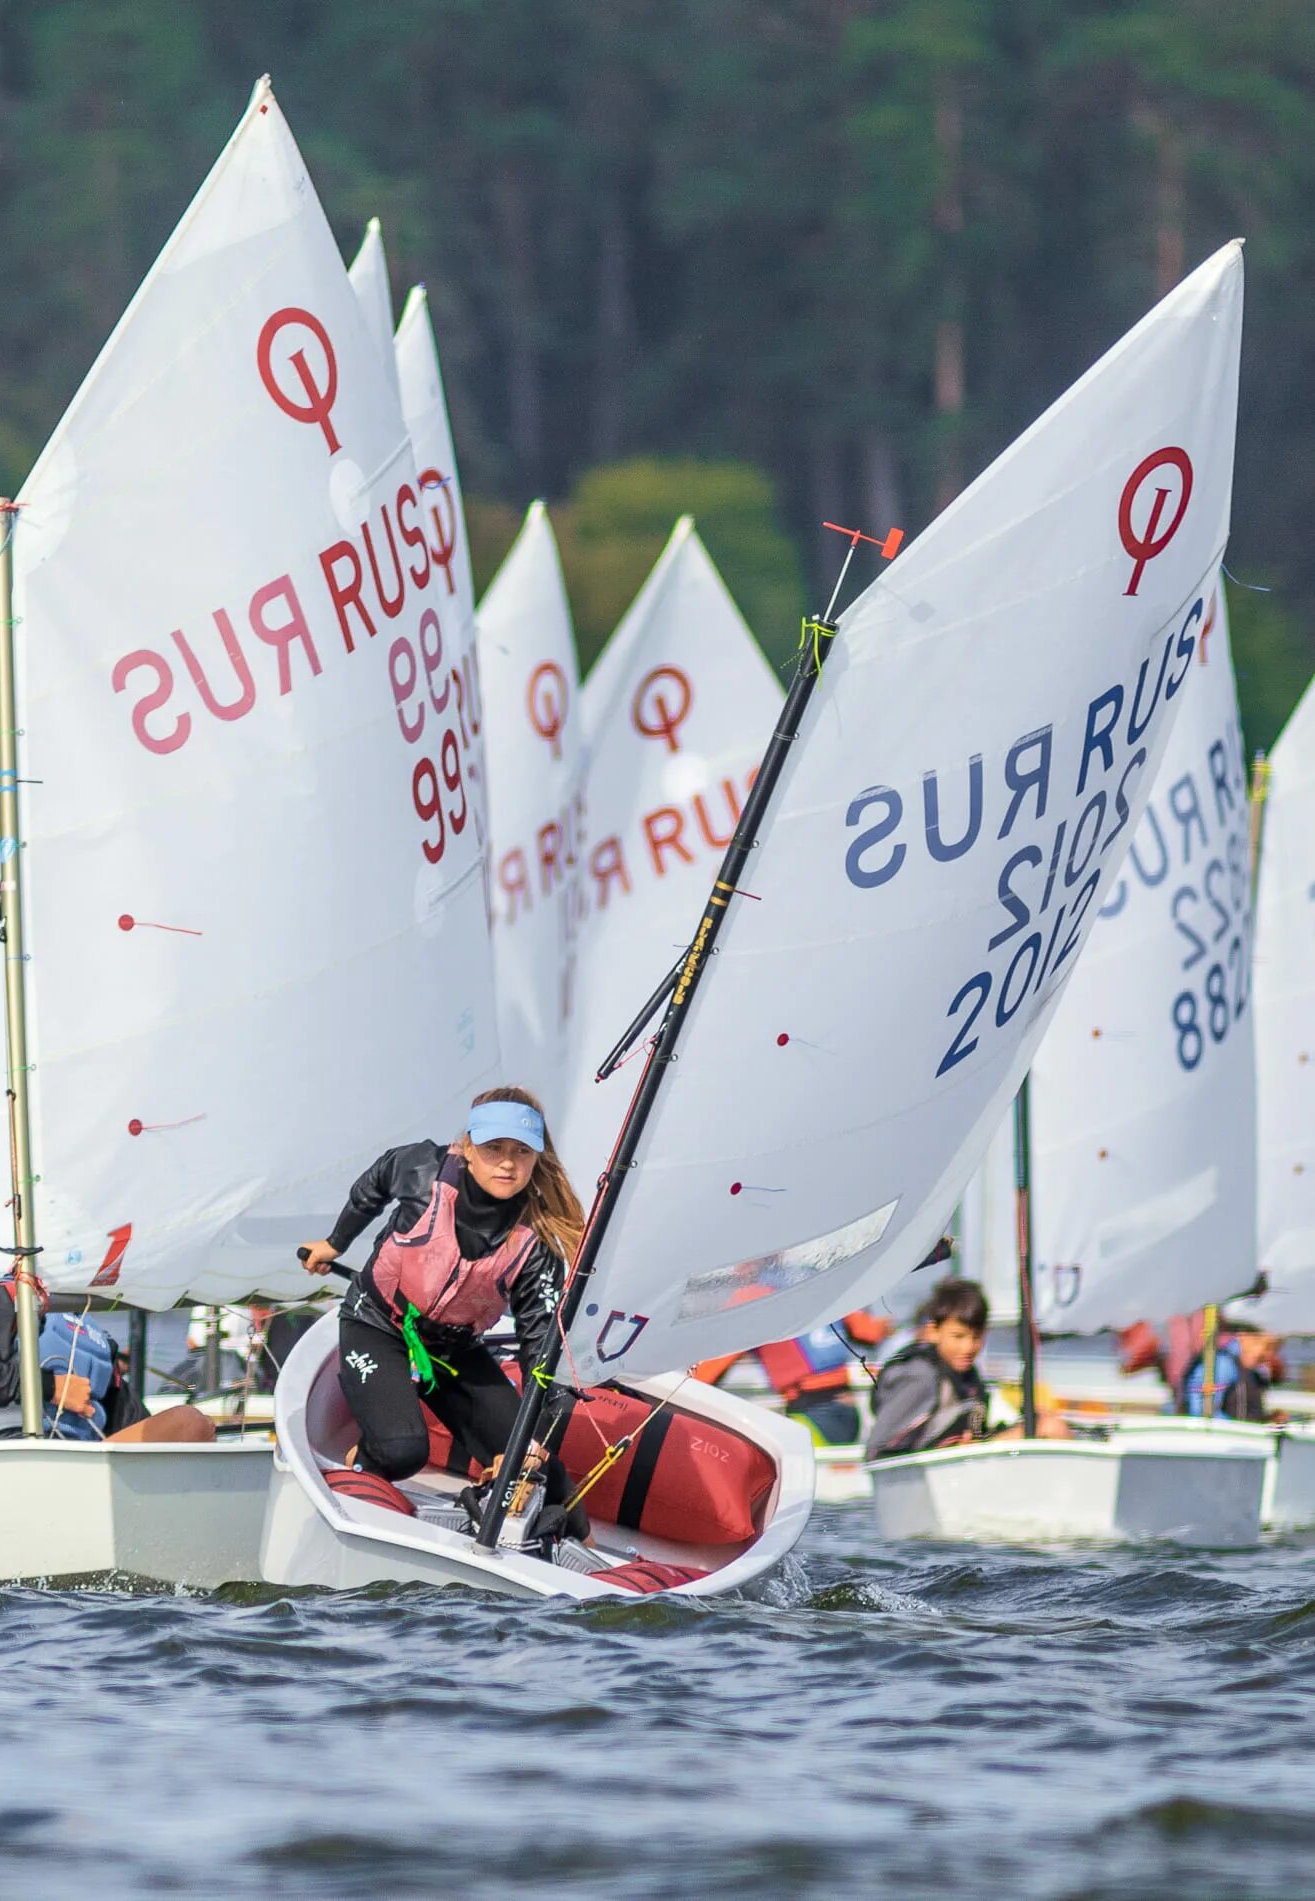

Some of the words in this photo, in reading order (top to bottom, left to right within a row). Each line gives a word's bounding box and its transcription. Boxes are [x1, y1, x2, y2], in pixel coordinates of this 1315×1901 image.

[318, 483, 431, 654] RUS
[1075, 597, 1202, 797] RUS
[641, 765, 760, 878] RU
[935, 868, 1101, 1079] 2012
[690, 1436, 730, 1463] 2012
